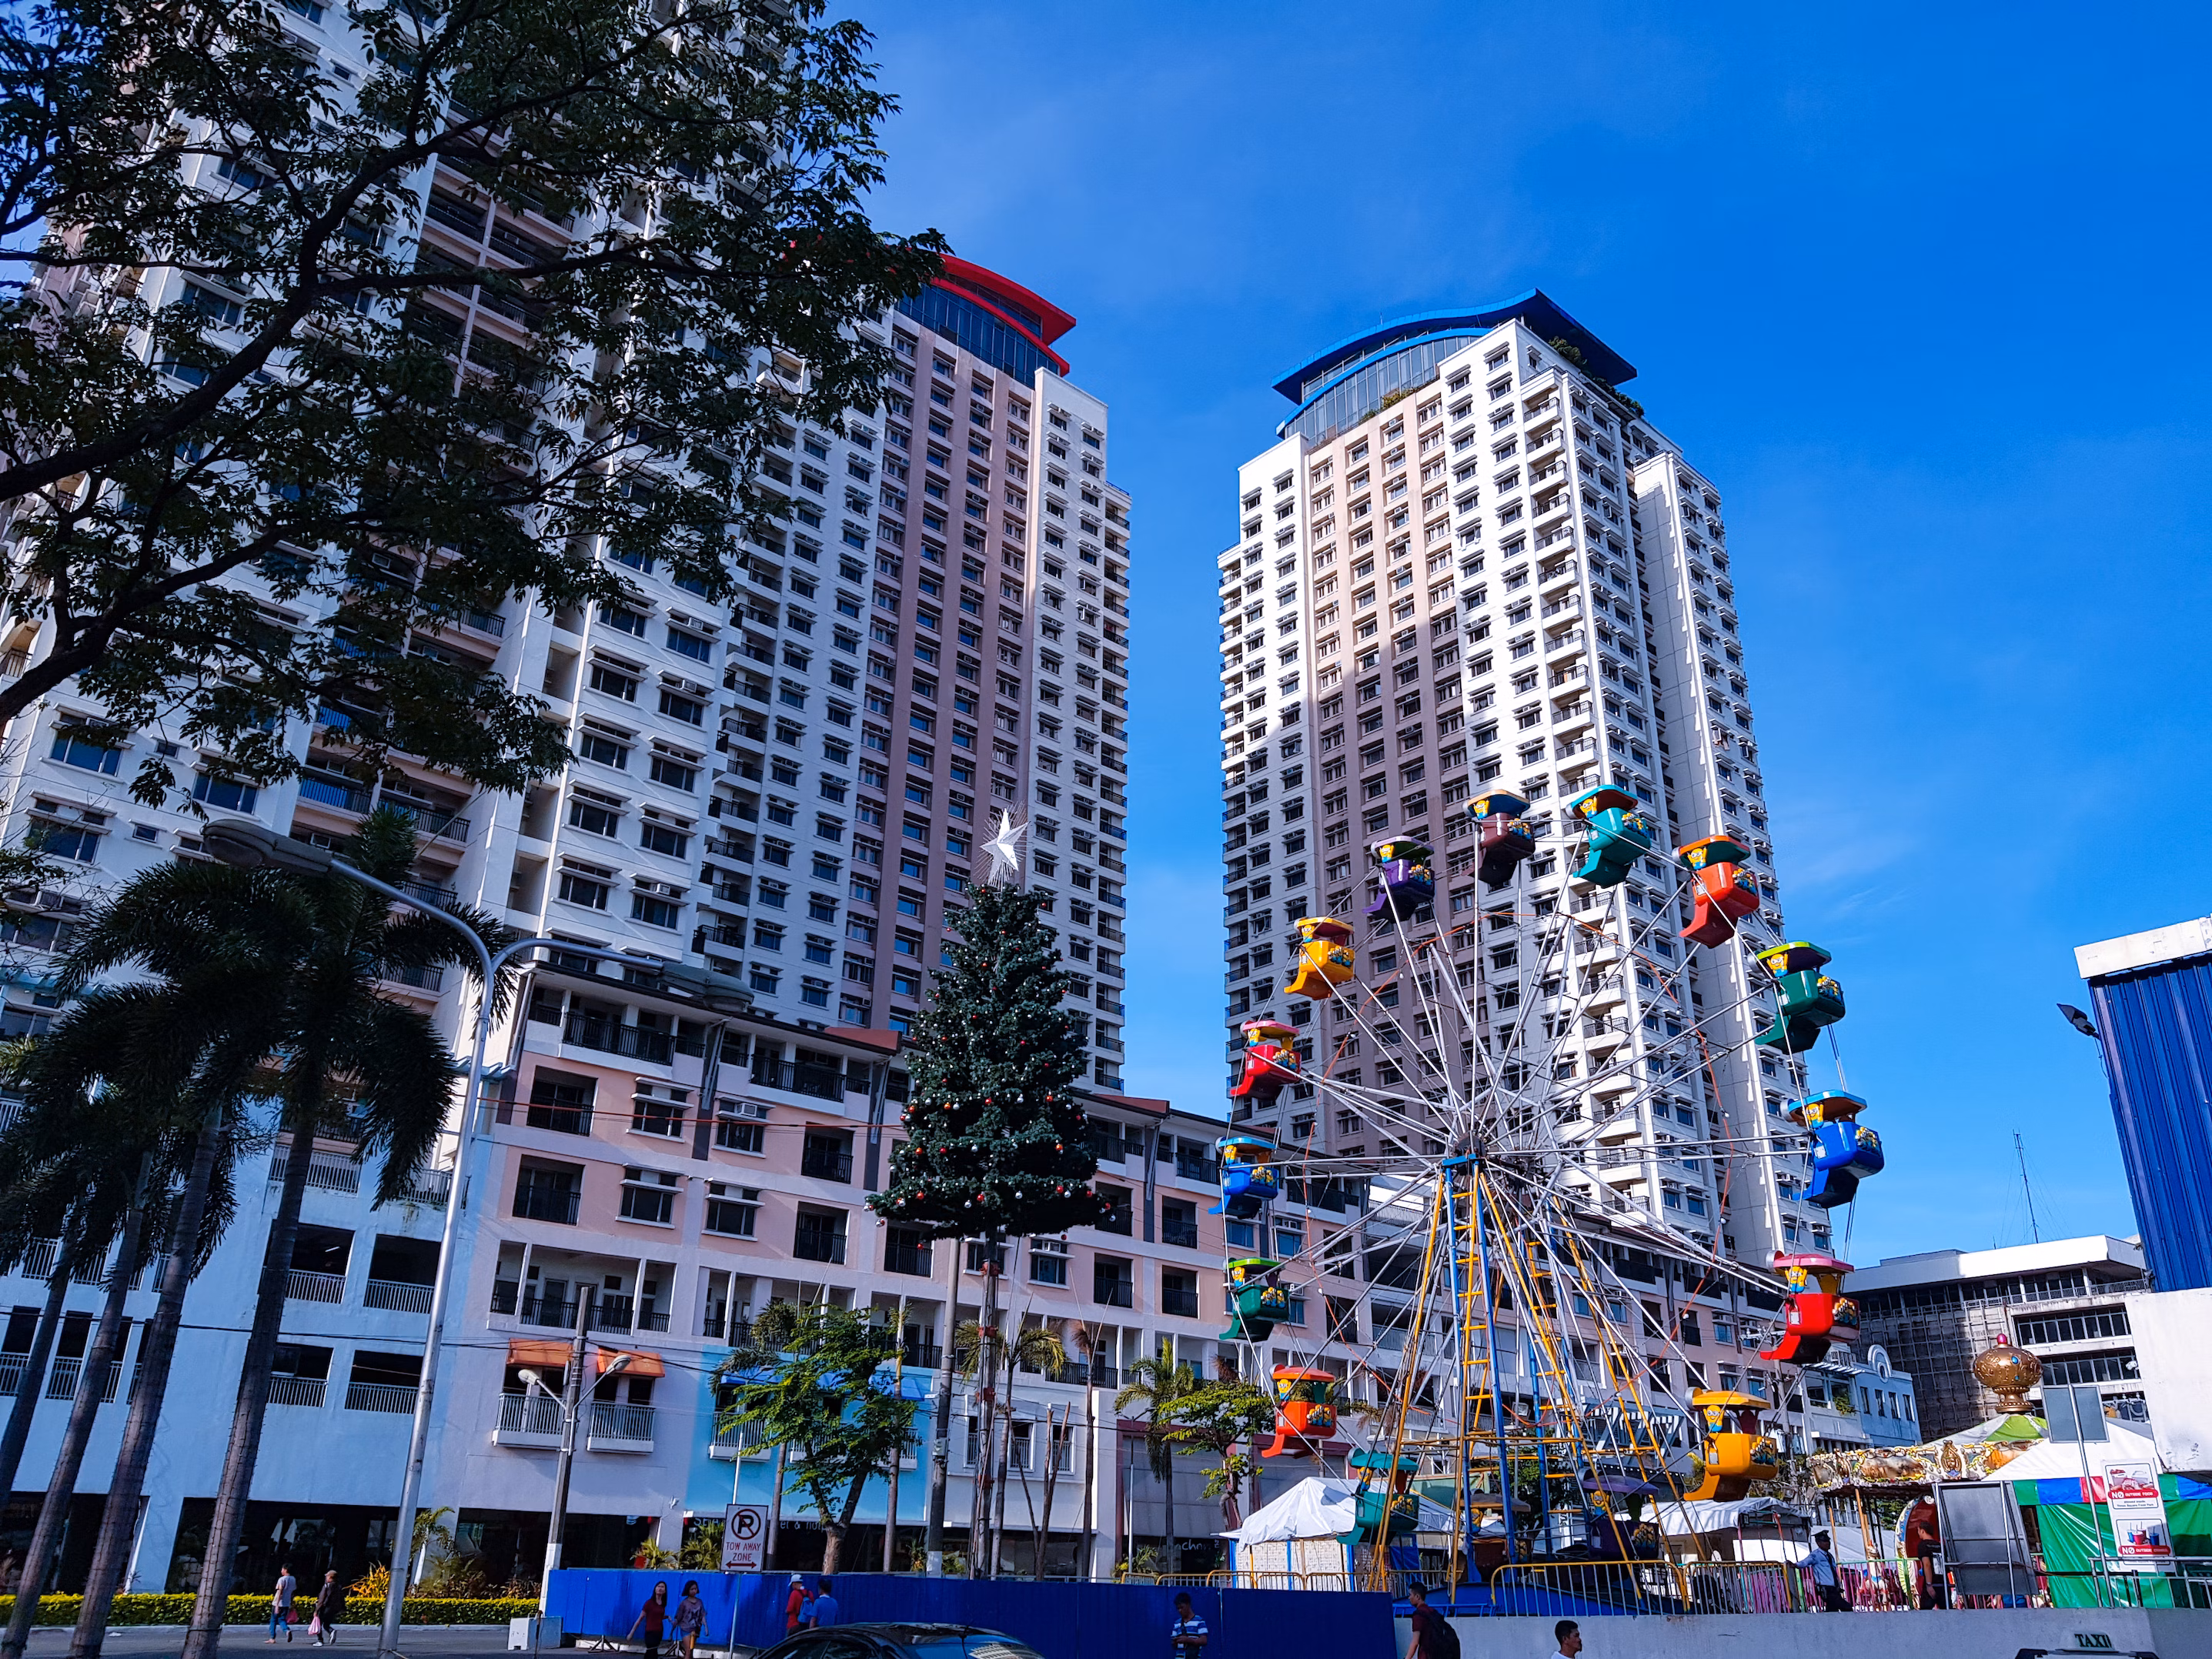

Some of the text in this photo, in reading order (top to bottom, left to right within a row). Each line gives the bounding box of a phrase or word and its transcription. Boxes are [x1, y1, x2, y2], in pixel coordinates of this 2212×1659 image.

[726, 1541, 761, 1551] TOW AWAY
[732, 1552, 753, 1561] ZONE
[2073, 1634, 2110, 1647] TAXI
